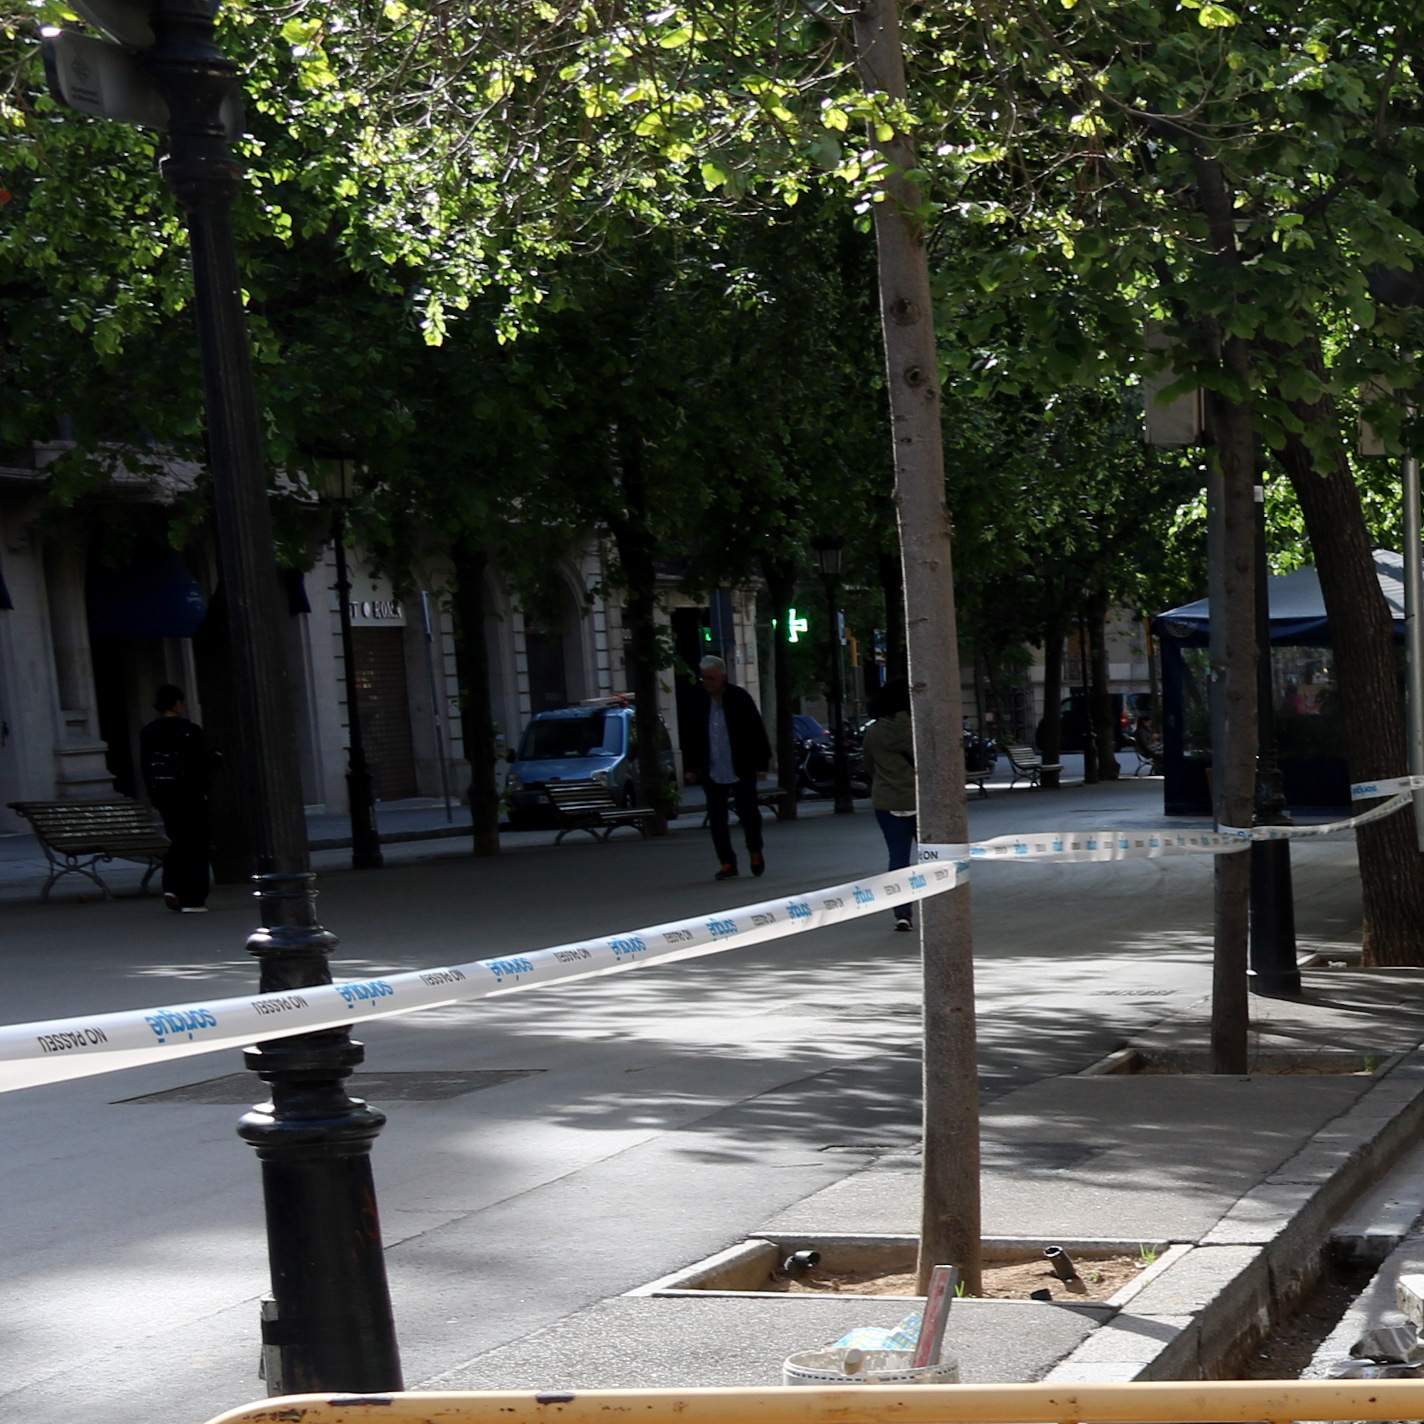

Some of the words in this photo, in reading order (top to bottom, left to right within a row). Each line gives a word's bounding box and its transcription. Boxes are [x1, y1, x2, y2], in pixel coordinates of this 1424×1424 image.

[251, 997, 293, 1016] PASSEU
[287, 994, 308, 1008] NO
[37, 1031, 88, 1053] PASSEU
[84, 1027, 108, 1045] NO
